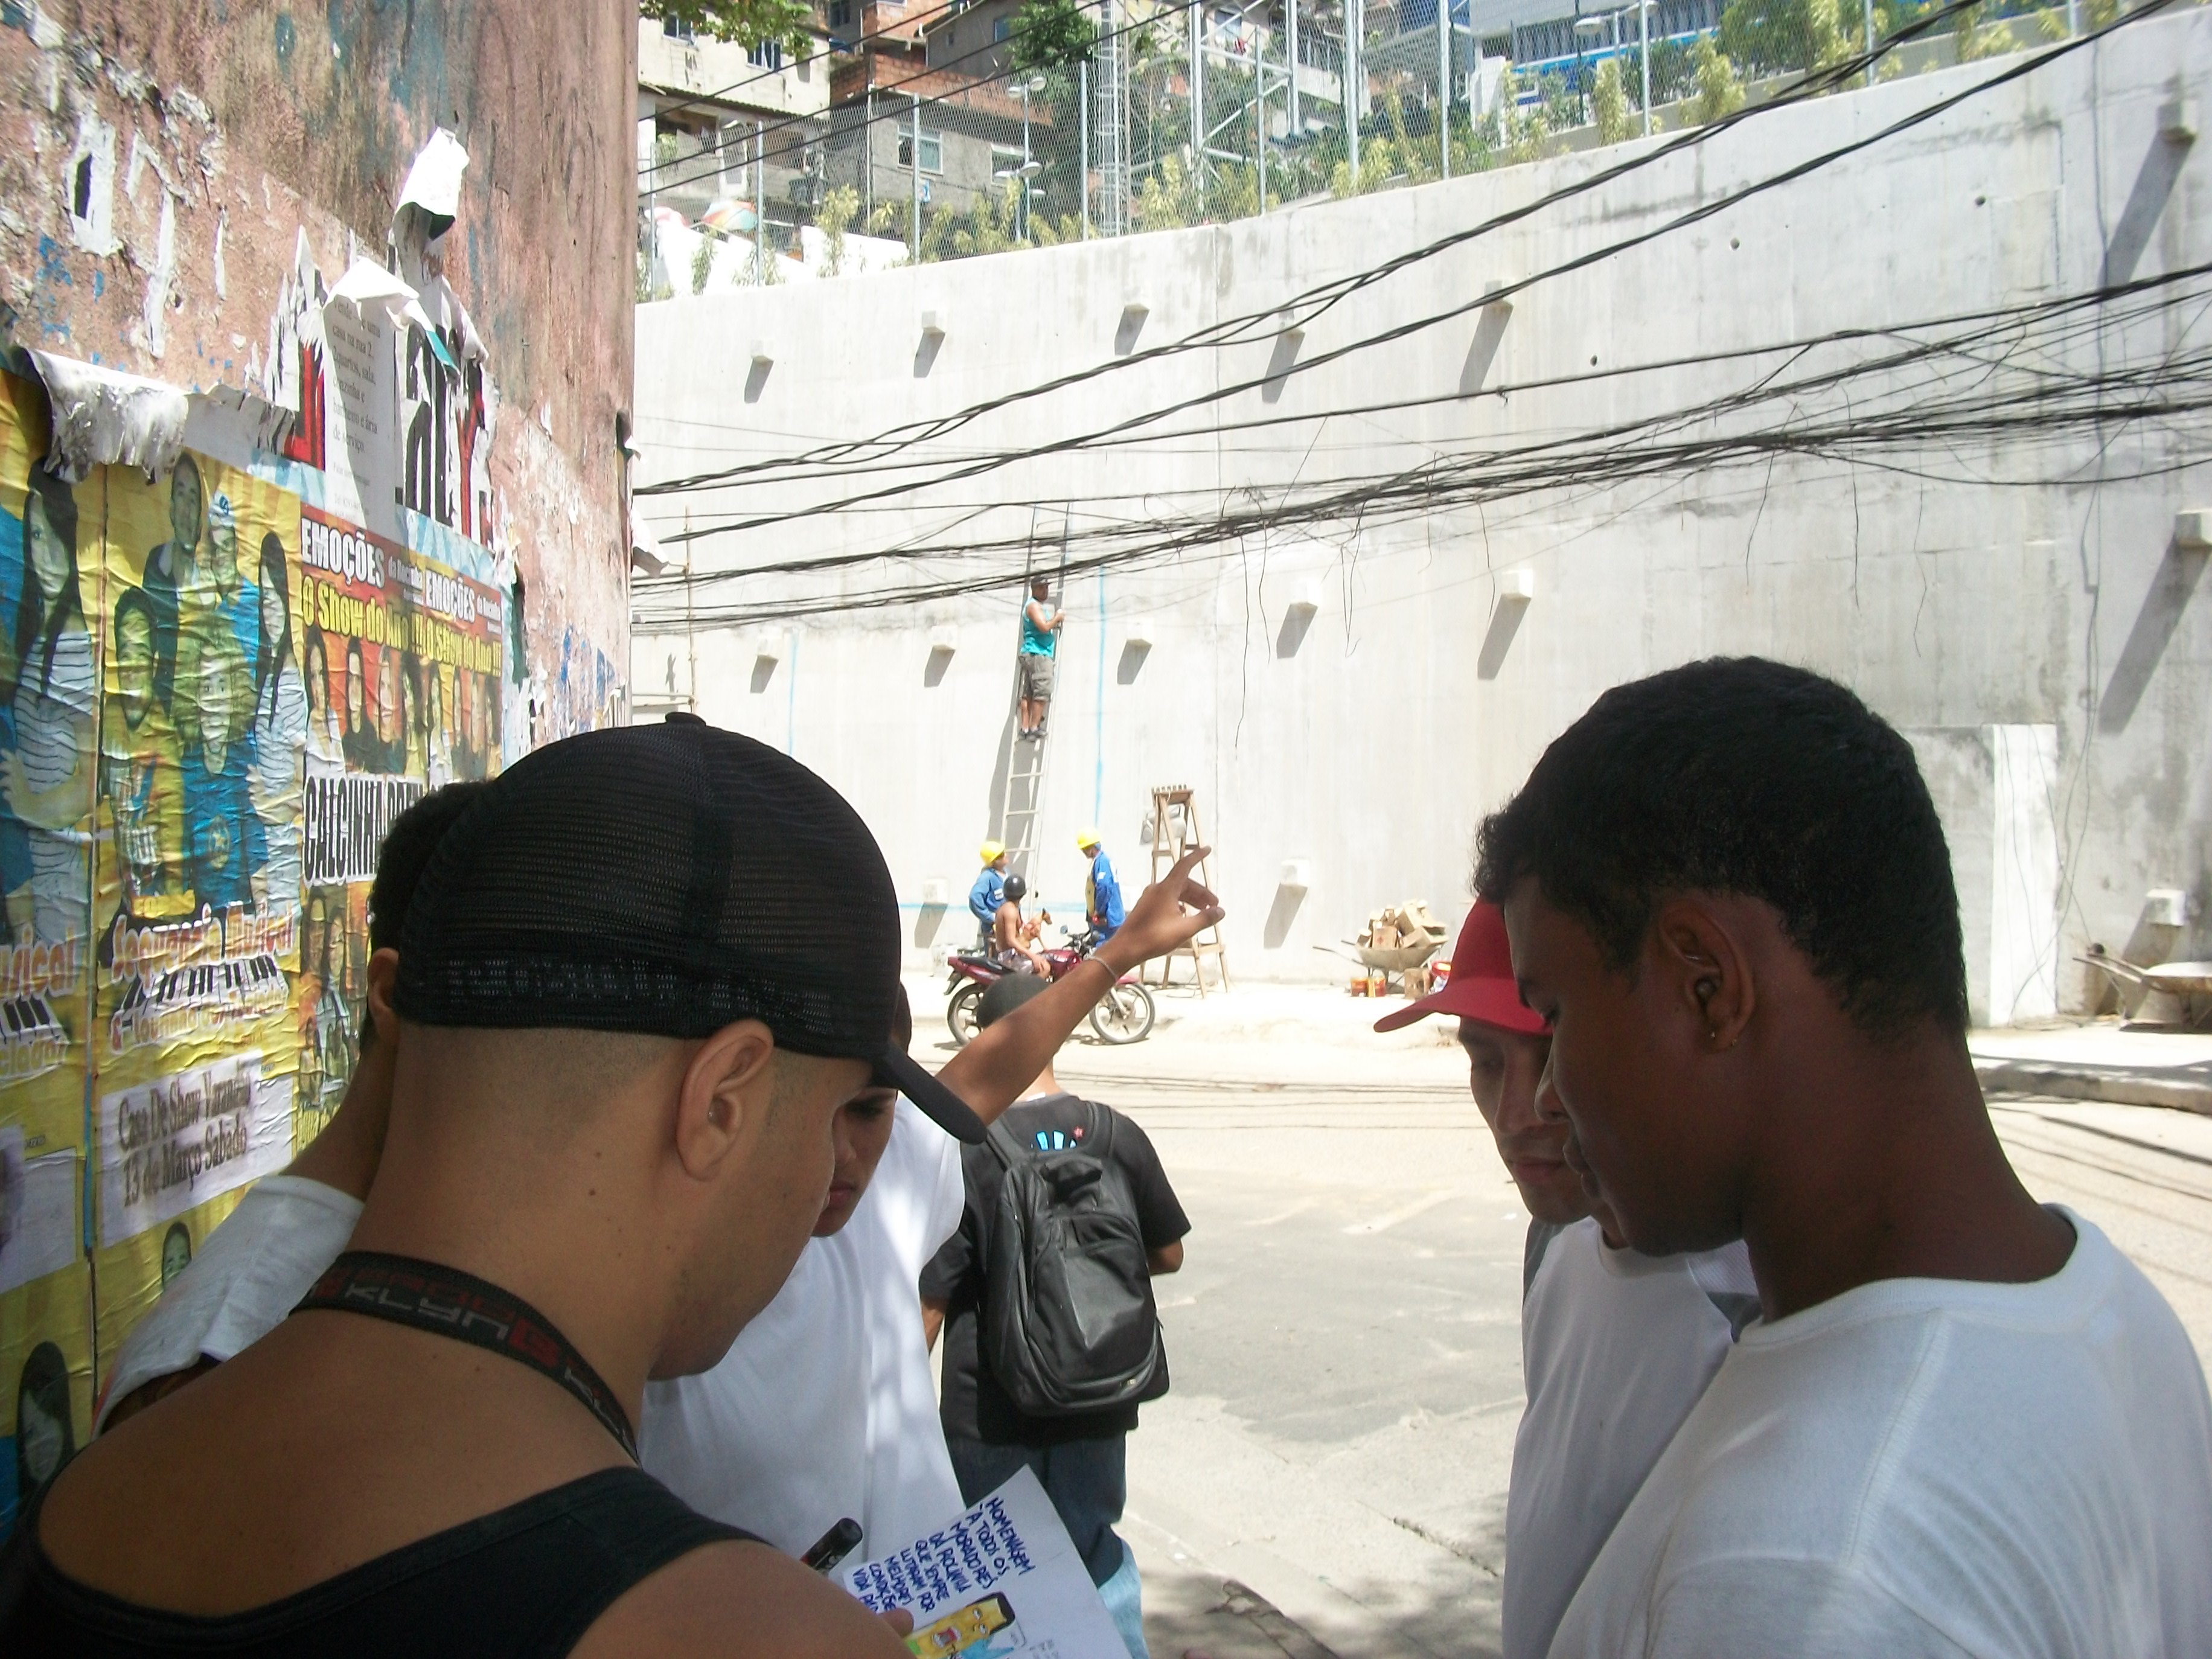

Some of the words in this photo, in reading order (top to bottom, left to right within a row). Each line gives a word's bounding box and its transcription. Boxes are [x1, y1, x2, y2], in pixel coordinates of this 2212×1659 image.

[333, 325, 346, 341] casa
[356, 339, 366, 354] rua
[301, 517, 385, 589] EMOÇÕES
[302, 575, 315, 627] O
[318, 580, 364, 638] Show
[366, 596, 385, 645] do
[386, 602, 409, 652] Ano
[426, 567, 475, 624] EMOÇÕES
[435, 622, 462, 667] Show
[463, 631, 474, 671] do
[475, 636, 491, 674] Ano
[304, 775, 385, 881] CALCINHA
[169, 1076, 201, 1136] Show
[162, 1140, 202, 1192] Março
[950, 1520, 999, 1590] MORADORES
[986, 1496, 1036, 1576] HOMENAGEM
